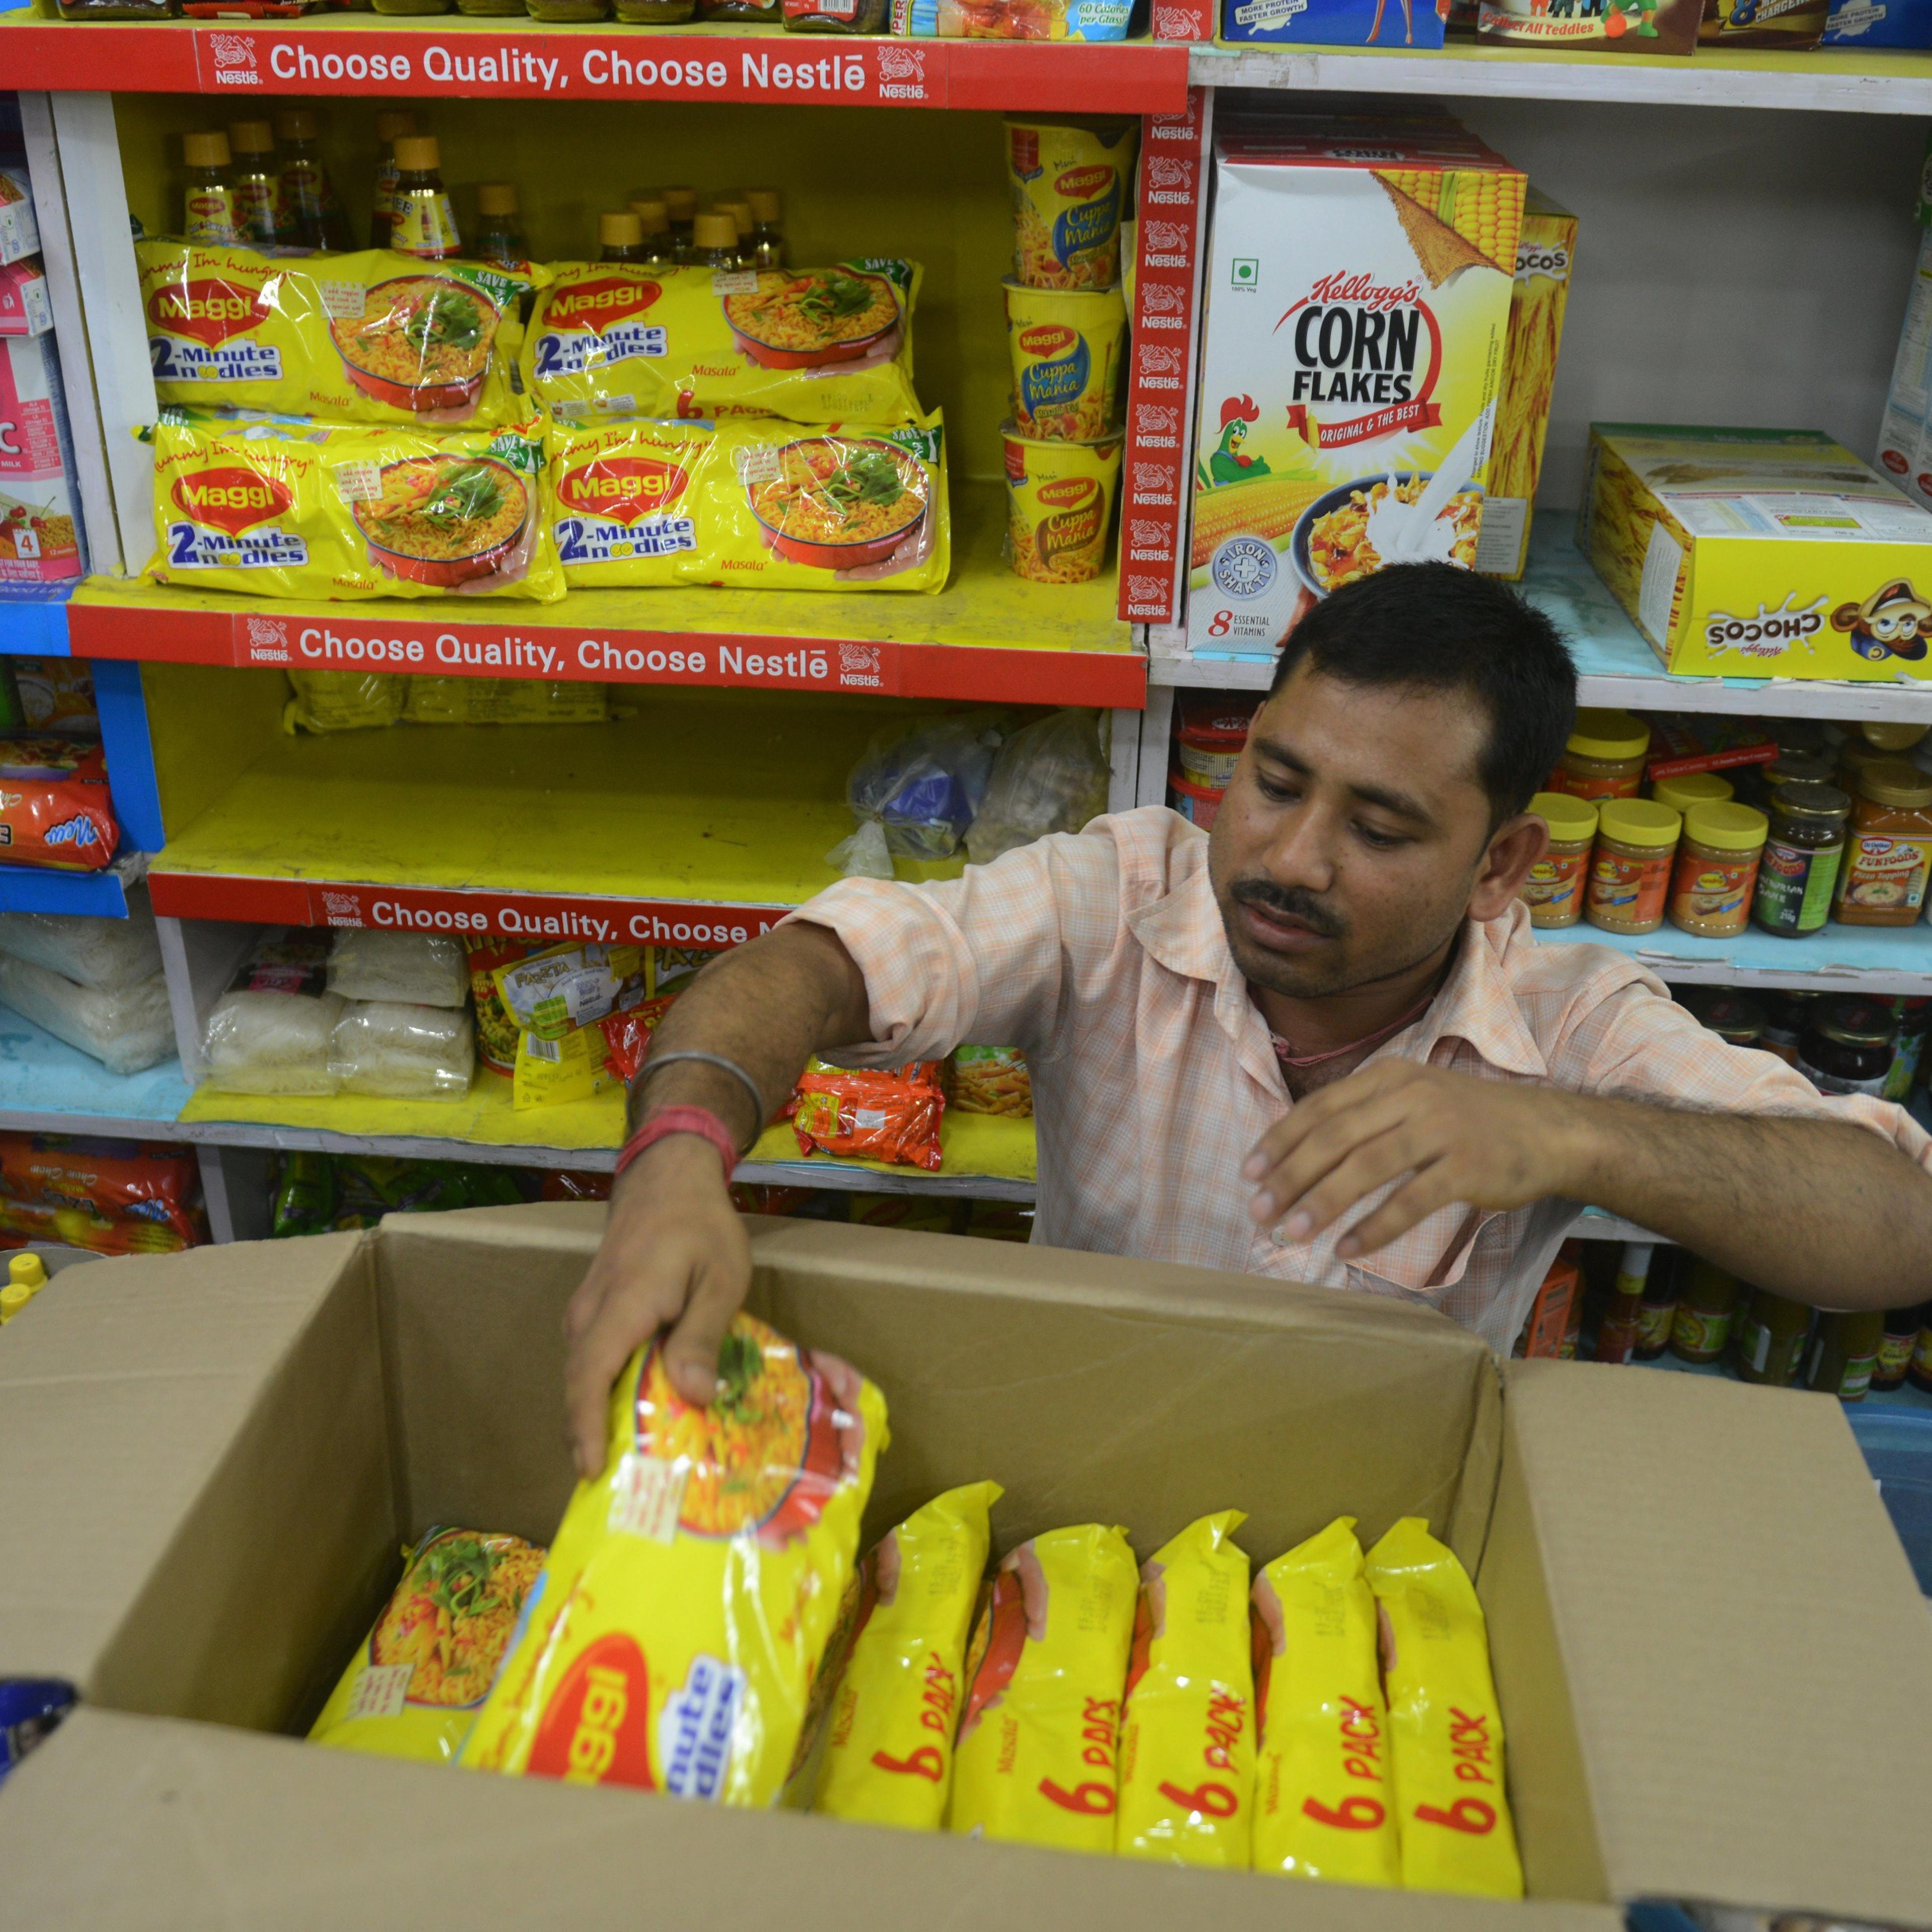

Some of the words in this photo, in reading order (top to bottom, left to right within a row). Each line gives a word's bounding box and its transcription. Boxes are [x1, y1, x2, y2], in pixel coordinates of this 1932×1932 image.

[1079, 4, 1092, 14] 60
[1095, 4, 1129, 14] Calories
[1239, 13, 1267, 23] FASTER
[1270, 4, 1304, 18] GROWTH
[1241, 5, 1263, 14] MORE
[1266, 0, 1299, 10] PROTEIN
[1829, 13, 1849, 22] MORE
[1850, 8, 1880, 18] PROTEIN
[1854, 12, 1884, 23] GROWTH
[1080, 16, 1096, 24] per
[1482, 13, 1523, 32] Collect
[1525, 23, 1543, 35] All
[1545, 23, 1594, 35] Teddies
[270, 44, 411, 79] Choose
[423, 46, 569, 91] Quality,
[583, 50, 727, 88] Choose
[1060, 169, 1106, 190] Maggi
[865, 258, 895, 270] SAVE
[475, 271, 507, 287] SAVE
[1311, 270, 1420, 311] Kellogg's
[158, 297, 251, 320] Maggi
[550, 285, 644, 317] Maggi
[1022, 330, 1066, 346] Maggi
[1294, 305, 1420, 372] CORN
[692, 364, 737, 377] Masala
[1029, 362, 1077, 383] Cuppa
[309, 391, 350, 407] Masala
[1029, 380, 1079, 399] Mania
[1292, 370, 1412, 405] FLAKES
[676, 389, 703, 419] 6
[892, 427, 921, 441] SAVE
[1321, 423, 1364, 442] ORIGINAL
[1367, 420, 1374, 431] &
[1377, 411, 1395, 428] THE
[1397, 405, 1420, 421] BEST
[491, 434, 518, 452] SAVE
[1, 460, 21, 468] MILK
[180, 484, 275, 509] Maggi
[571, 471, 671, 499] Maggi
[1042, 481, 1088, 500] Maggi
[1048, 509, 1095, 532] Cuppa
[21, 534, 33, 552] 4
[592, 535, 692, 558] noodles
[1046, 526, 1094, 550] Mania
[201, 551, 305, 567] noodles
[1231, 543, 1266, 562] IRON
[720, 559, 764, 572] Masala
[333, 577, 374, 591] Masala
[1219, 569, 1271, 595] SHAKTI
[1208, 610, 1233, 636] 8
[1234, 615, 1270, 626] ESSENTIAL
[1233, 626, 1266, 637] VITAMINS
[1709, 613, 1821, 646] CHOCOS
[299, 628, 424, 662] Choose
[435, 633, 565, 673] Quality,
[578, 640, 706, 673] Choose
[1740, 646, 1783, 658] Kellogg's
[45, 815, 99, 847] New
[1859, 851, 1919, 866] FUNFOODS
[1878, 869, 1910, 879] Topping
[372, 901, 489, 931] Choose
[498, 908, 618, 942] Quality,
[628, 915, 748, 944] Choose
[515, 960, 572, 988] PAZZTA
[833, 1690, 858, 1747] Masala
[997, 1716, 1019, 1775] Masala
[1339, 1695, 1384, 1782] PACK
[1448, 1707, 1495, 1786] PACK
[870, 1745, 944, 1784] 6
[1157, 1781, 1239, 1818] 6
[1204, 1688, 1247, 1774] PACK
[1038, 1777, 1117, 1816] 6
[1302, 1795, 1386, 1831] 6
[1413, 1797, 1498, 1836] 6
